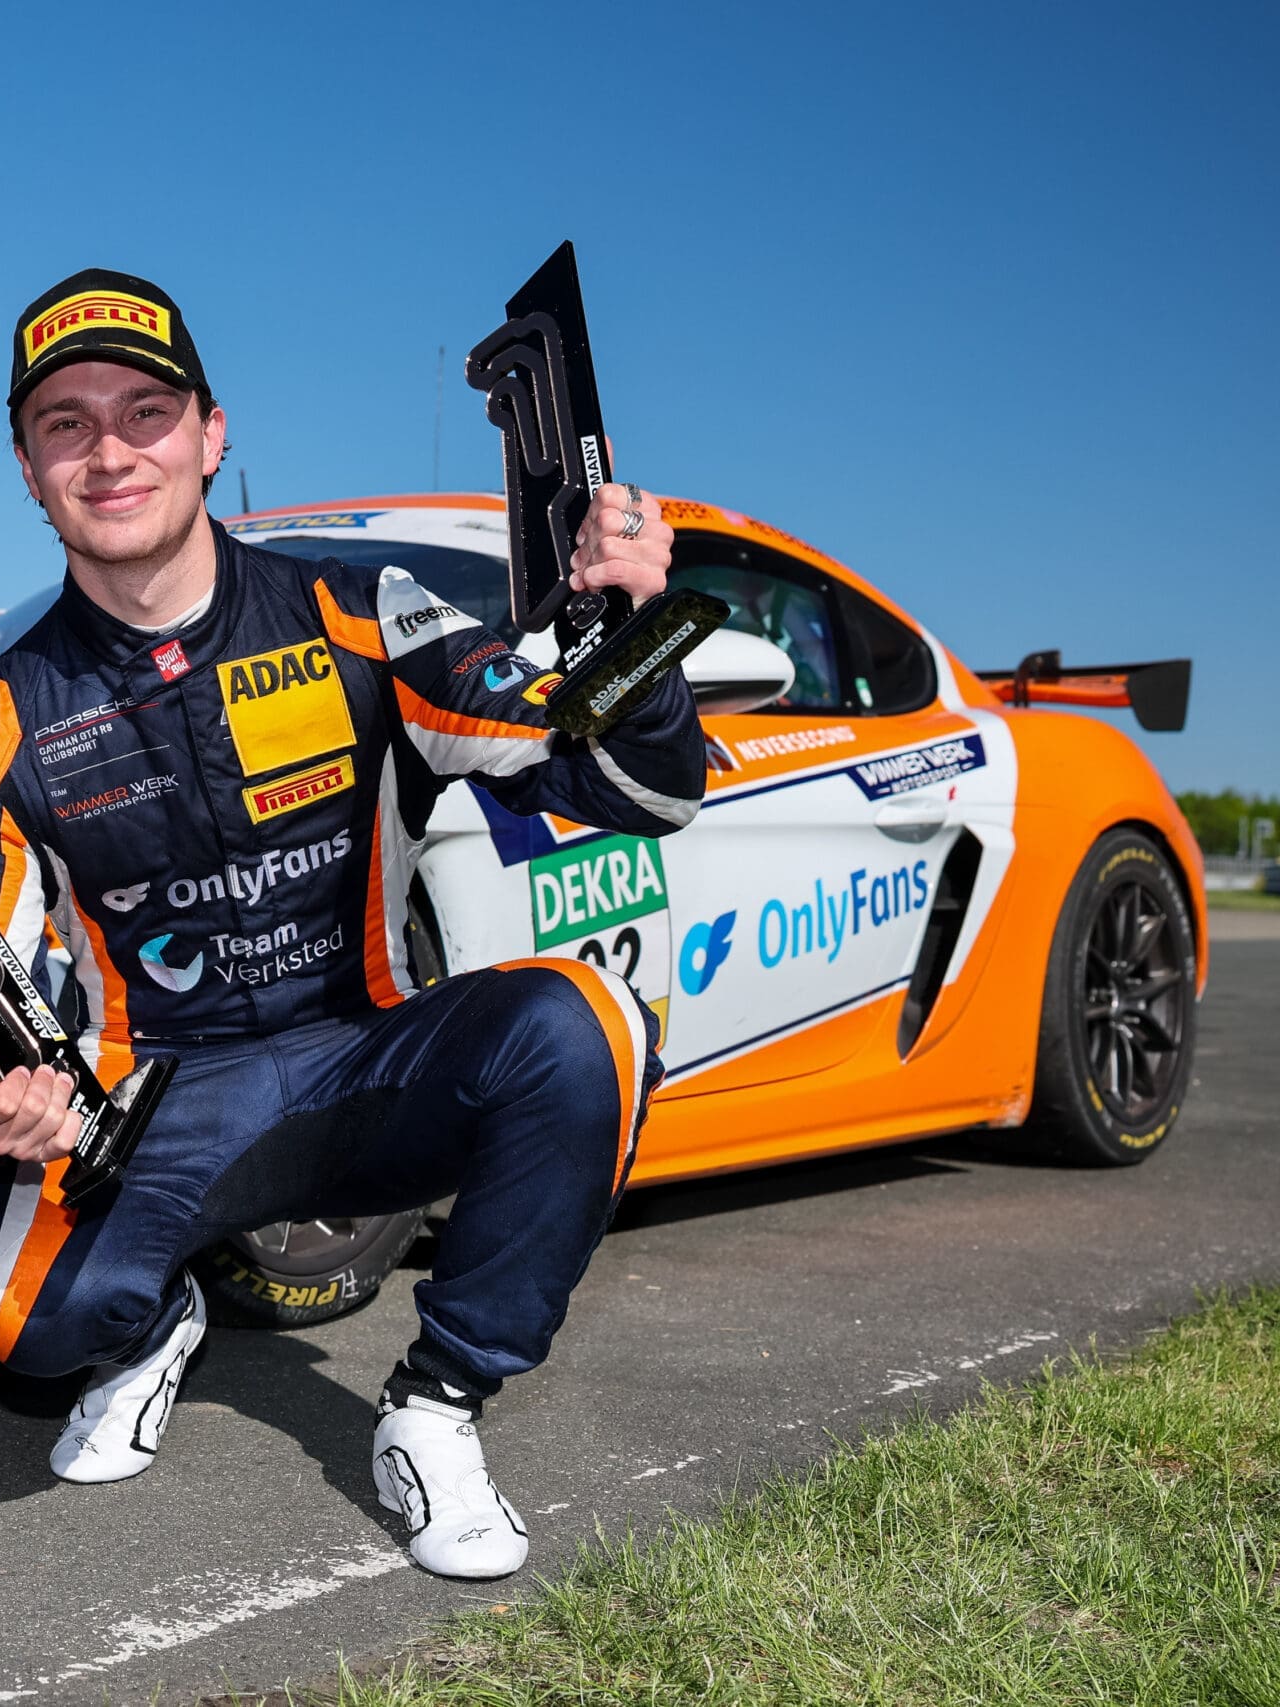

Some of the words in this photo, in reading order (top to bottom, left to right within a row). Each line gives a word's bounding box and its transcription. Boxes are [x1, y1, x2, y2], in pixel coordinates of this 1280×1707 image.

[31, 296, 158, 351] PIRELLI
[393, 604, 459, 638] freem
[563, 620, 605, 662] PLACE
[155, 641, 183, 672] Sport
[171, 659, 187, 675] Bild
[566, 645, 594, 672] RACE
[628, 623, 692, 684] GERMANY
[230, 645, 331, 704] ADAC
[589, 674, 625, 709] ADAC
[34, 696, 137, 740] PORSCHE
[38, 733, 79, 757] CAYMAN
[80, 726, 99, 744] GT4
[41, 738, 98, 766] CLUBSPORT
[734, 724, 857, 762] NEVERSECOND
[855, 751, 932, 788] WIMMER
[921, 739, 977, 768] WERK
[50, 788, 67, 799] TEAM
[54, 786, 129, 819] WIMMER
[129, 773, 180, 795] WERK
[83, 789, 162, 821] MOTORSPORT
[253, 765, 344, 815] PIRELLI
[167, 828, 353, 908] OnlyFans
[534, 840, 664, 935] DEKRA
[758, 859, 929, 969] OnlyFans
[209, 921, 299, 959] Team
[214, 923, 344, 985] Verksted
[18, 999, 52, 1039] ADAC
